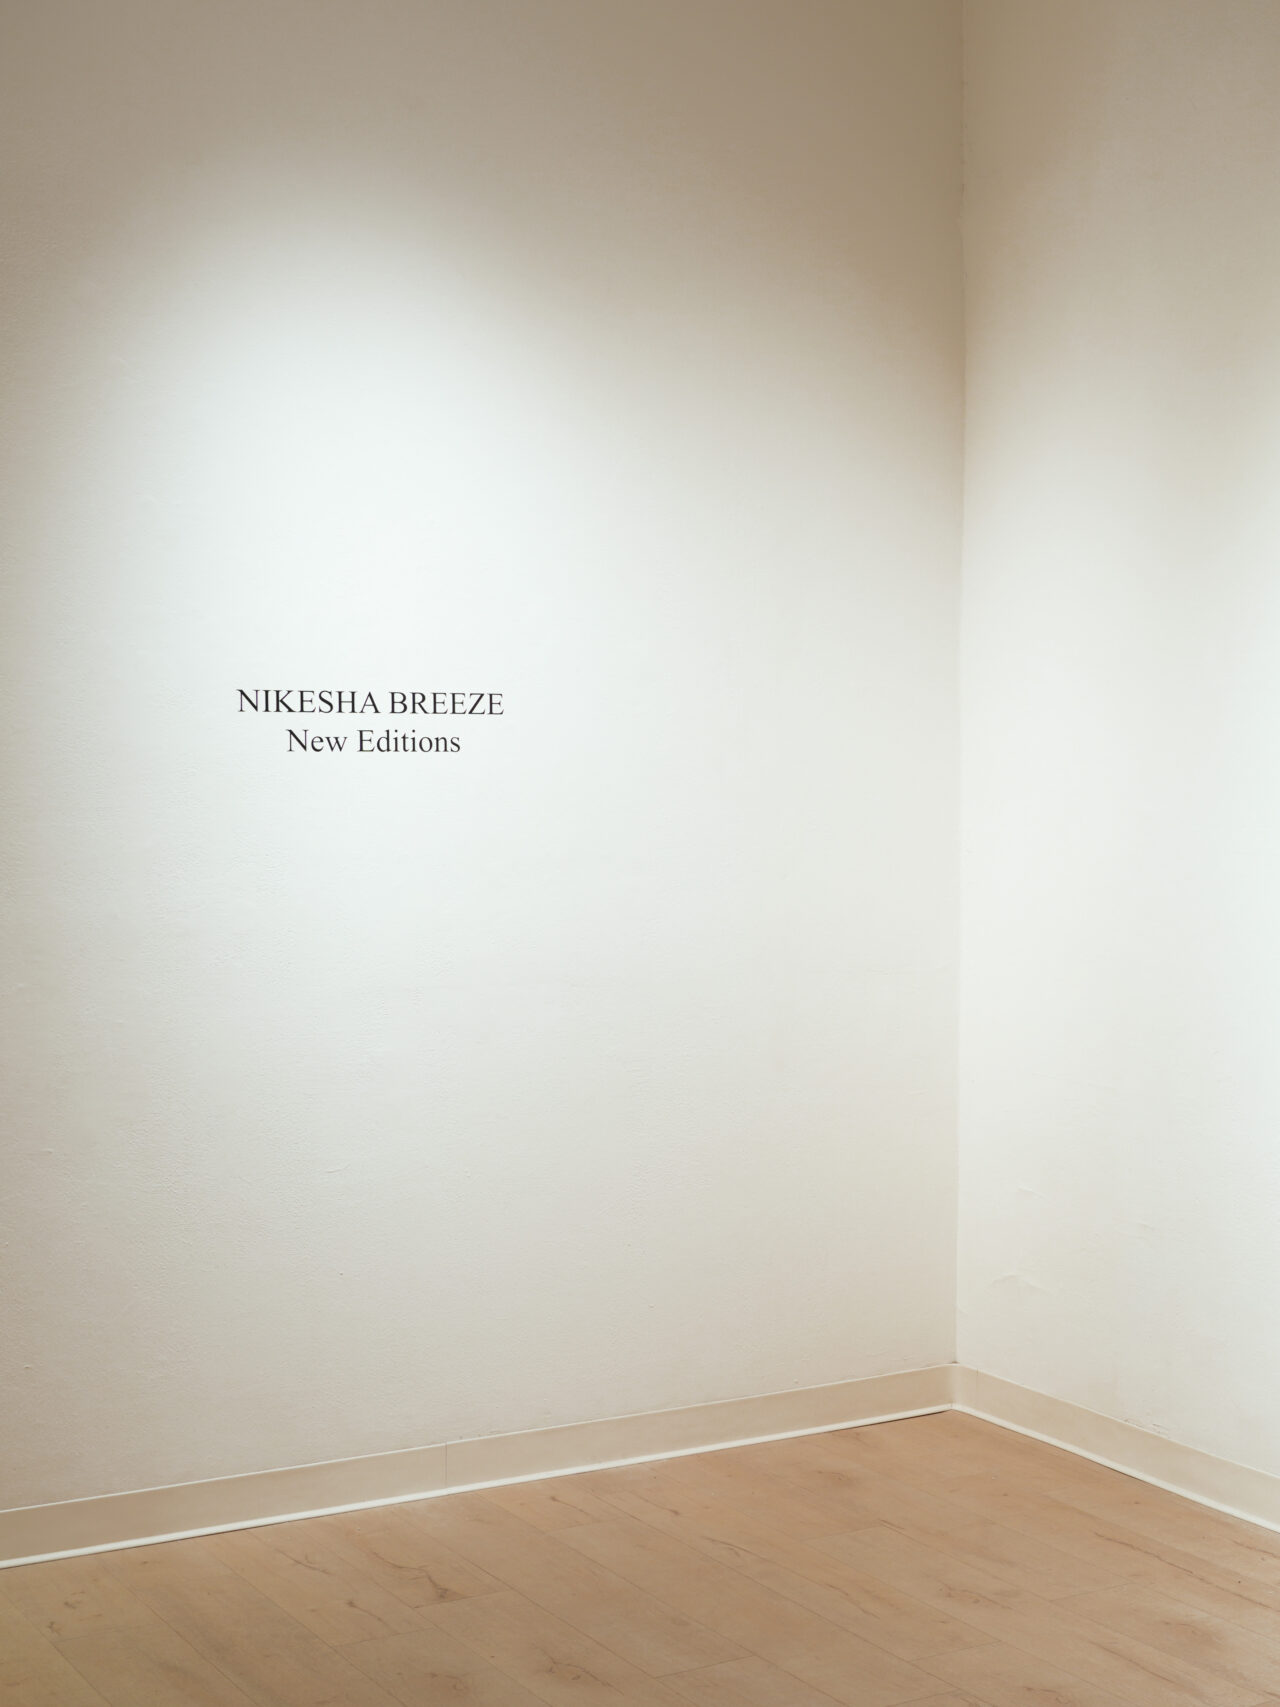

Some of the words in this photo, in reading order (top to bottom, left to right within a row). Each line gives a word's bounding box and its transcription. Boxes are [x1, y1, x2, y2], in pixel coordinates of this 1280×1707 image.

[237, 689, 381, 714] NIKESHA
[389, 691, 504, 715] BREEZE
[287, 729, 348, 752] New
[358, 729, 461, 753] Editions
